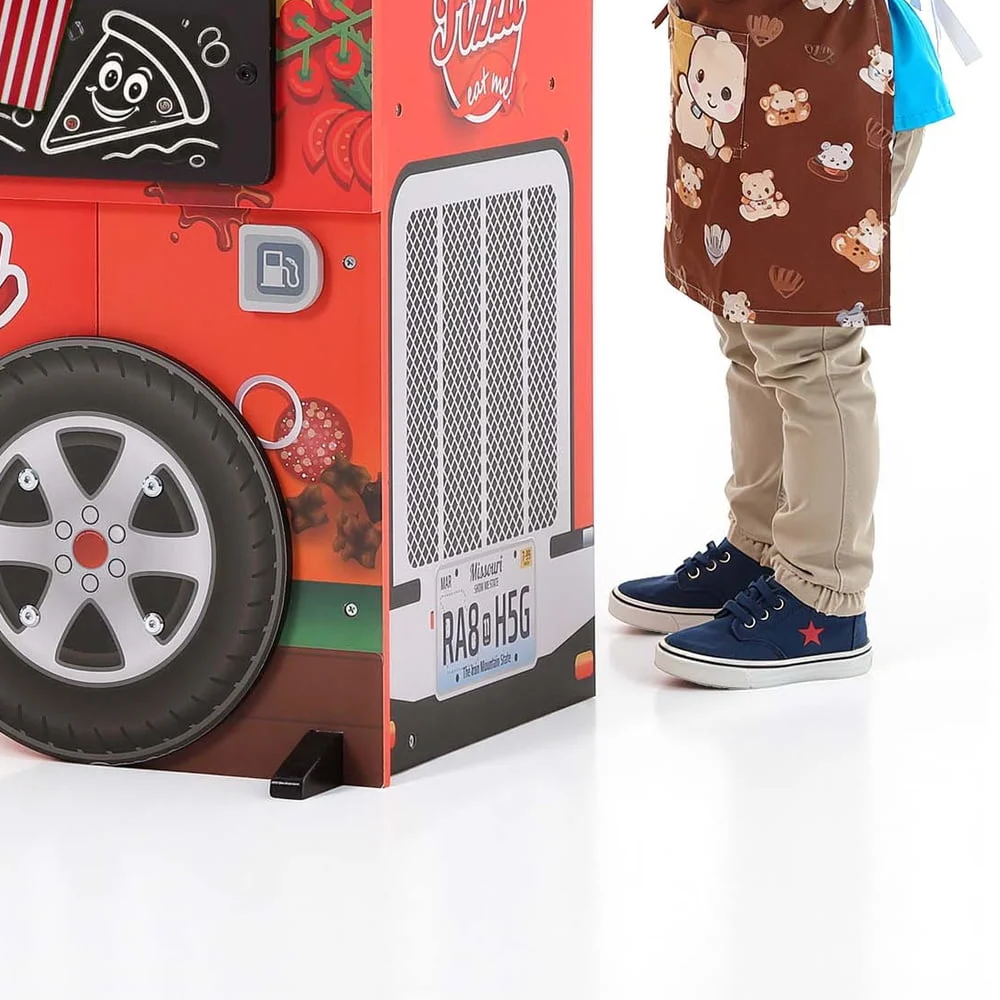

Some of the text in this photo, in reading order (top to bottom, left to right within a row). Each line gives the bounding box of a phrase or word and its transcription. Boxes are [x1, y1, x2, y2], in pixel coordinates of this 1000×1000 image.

[467, 65, 490, 107] eat
[440, 574, 452, 590] MAR
[470, 555, 503, 582] Missouri
[442, 585, 530, 666] RA8 H5G
[500, 651, 511, 666] State
